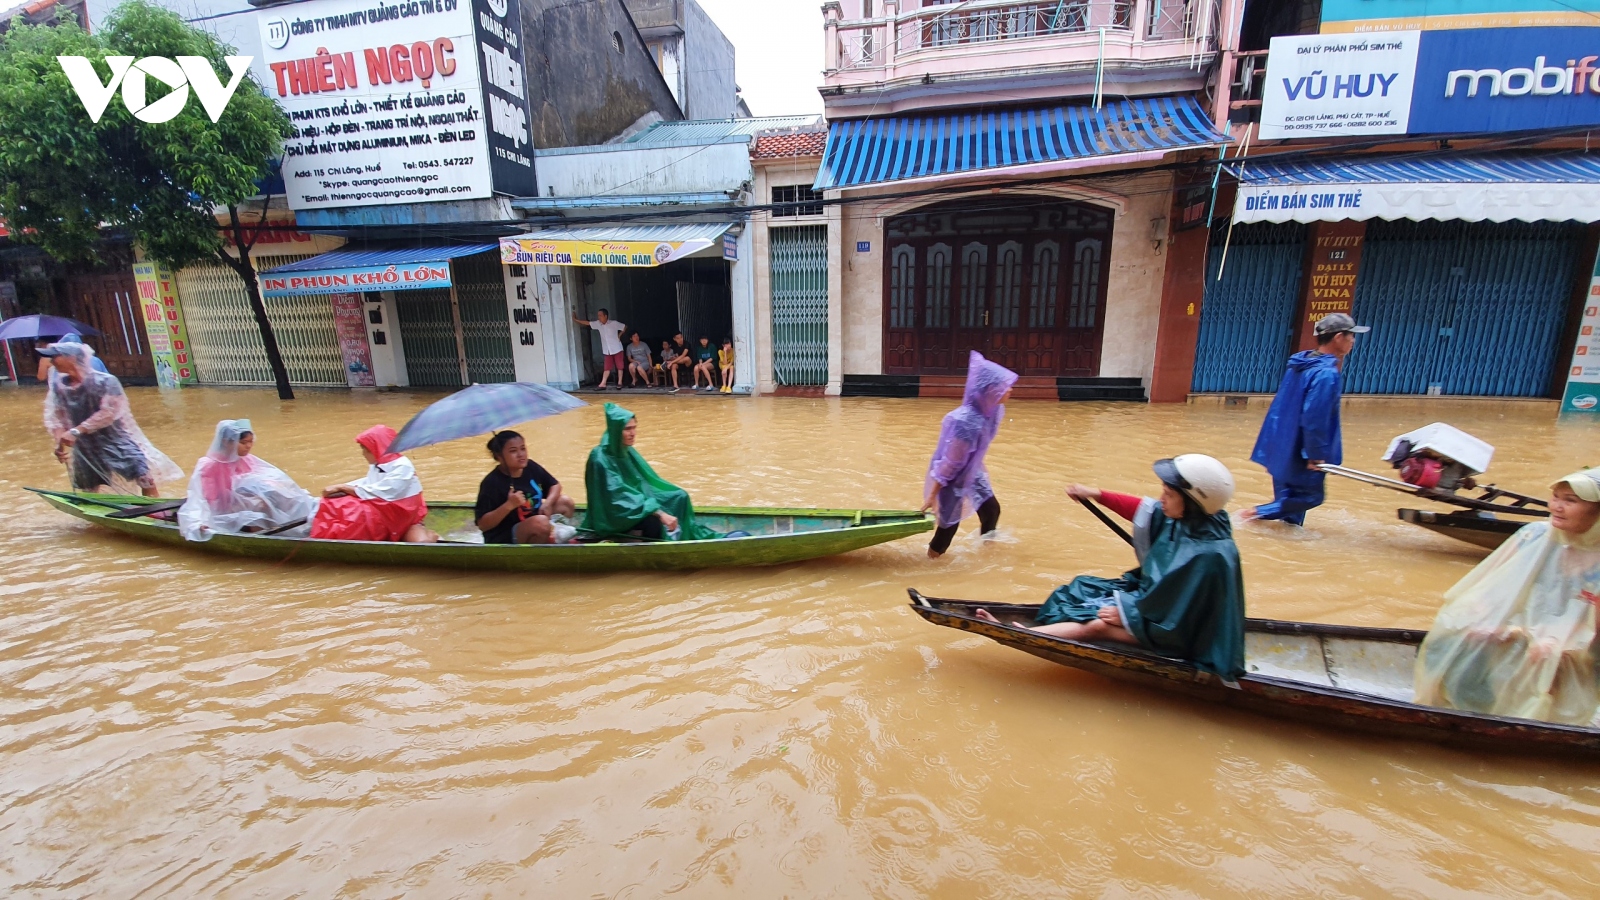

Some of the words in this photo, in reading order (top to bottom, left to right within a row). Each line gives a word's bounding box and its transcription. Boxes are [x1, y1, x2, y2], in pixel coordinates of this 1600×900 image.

[291, 17, 314, 35] CÔNG
[314, 18, 325, 32] TY
[349, 12, 367, 26] MTV
[421, 0, 434, 14] TM
[1297, 47, 1311, 56] ĐẠI
[1313, 42, 1322, 54] LÝ
[270, 47, 358, 97] THIÊN
[364, 37, 456, 88] NGỌC
[481, 41, 524, 100] THIÊN
[1282, 70, 1328, 102] VŨ
[1332, 73, 1399, 99] HUY
[292, 109, 314, 122] PHUN
[315, 107, 330, 119] KTS
[400, 92, 413, 110] KẾ
[365, 117, 394, 132] TRANG
[489, 92, 528, 149] NGỌC
[410, 132, 432, 146] MIKA
[458, 130, 476, 142] LED
[495, 146, 506, 158] 115
[506, 150, 516, 163] CHI
[403, 161, 418, 170] Tel:
[418, 158, 442, 168] 0543.
[444, 157, 474, 166] 547227
[294, 167, 312, 178] Add:
[313, 168, 325, 177] 115
[352, 174, 439, 187] quangcaothienngoc
[330, 184, 472, 202] thienngocquangcao@gmail.com
[1245, 190, 1280, 211] ĐIỂM
[1281, 190, 1308, 210] BÁN
[1310, 194, 1336, 210] SIM
[1337, 188, 1363, 208] THẺ
[556, 252, 572, 264] CUA
[580, 251, 602, 264] CHÁO
[1330, 250, 1345, 259] 121
[1316, 264, 1337, 272] ĐẠI
[1340, 262, 1354, 270] LÝ
[264, 278, 288, 292] IN
[291, 274, 348, 289] PHUN
[353, 264, 400, 285] KHỔ
[404, 266, 448, 282] LỚN
[1312, 273, 1330, 286] VŨ
[1330, 274, 1356, 286] HUY
[516, 282, 527, 300] KẾ
[1314, 288, 1350, 298] VINA
[1311, 301, 1350, 310] VIETTEL
[514, 305, 537, 324] QUẢNG
[520, 328, 534, 346] CÁO
